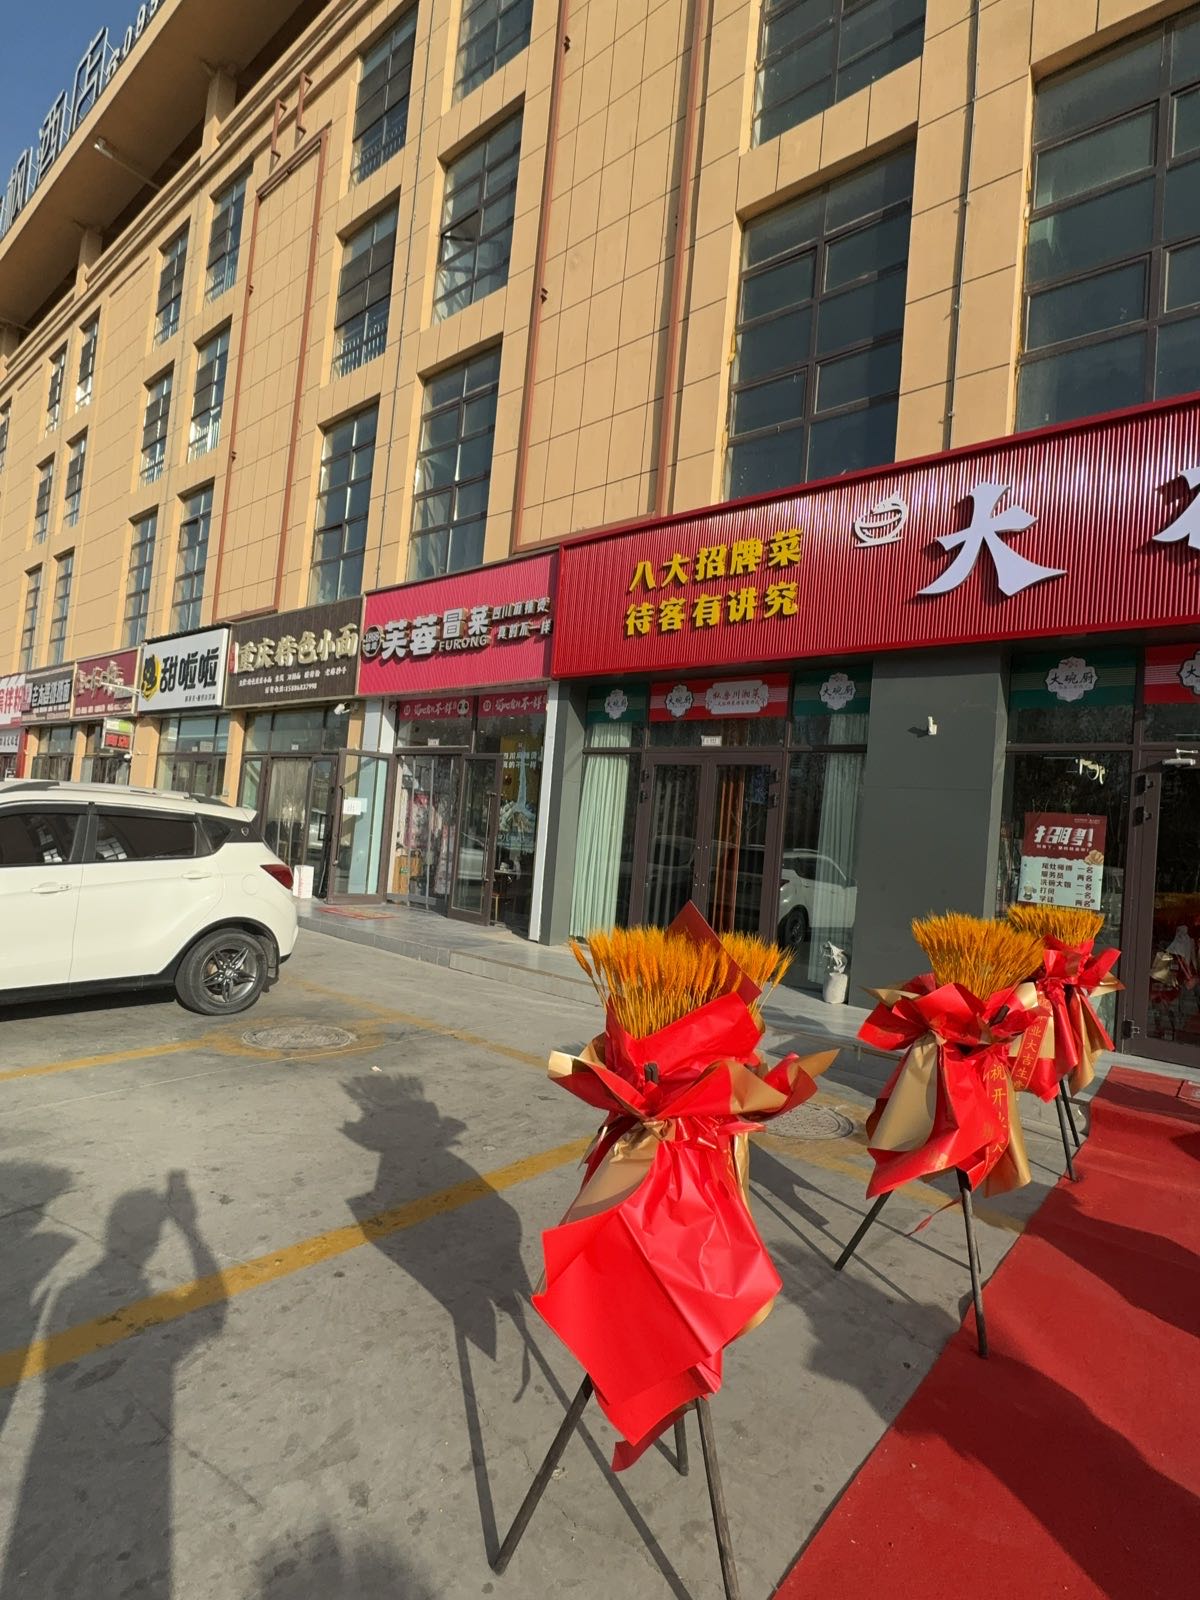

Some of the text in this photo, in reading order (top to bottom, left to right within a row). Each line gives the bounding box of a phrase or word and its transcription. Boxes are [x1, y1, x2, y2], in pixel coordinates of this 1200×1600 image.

[628, 528, 804, 593] 八大招牌菜
[625, 580, 799, 638] 待客有讲究
[380, 604, 490, 660] 芙蓉冒菜
[437, 634, 488, 652] FURONG
[159, 647, 220, 694] 甜啦啦
[1049, 670, 1094, 686] 大碗厨
[1041, 871, 1093, 883] 服务员 两名
[1077, 866, 1094, 874] 一名
[1075, 891, 1092, 900] 一名
[1076, 883, 1092, 891] 一名
